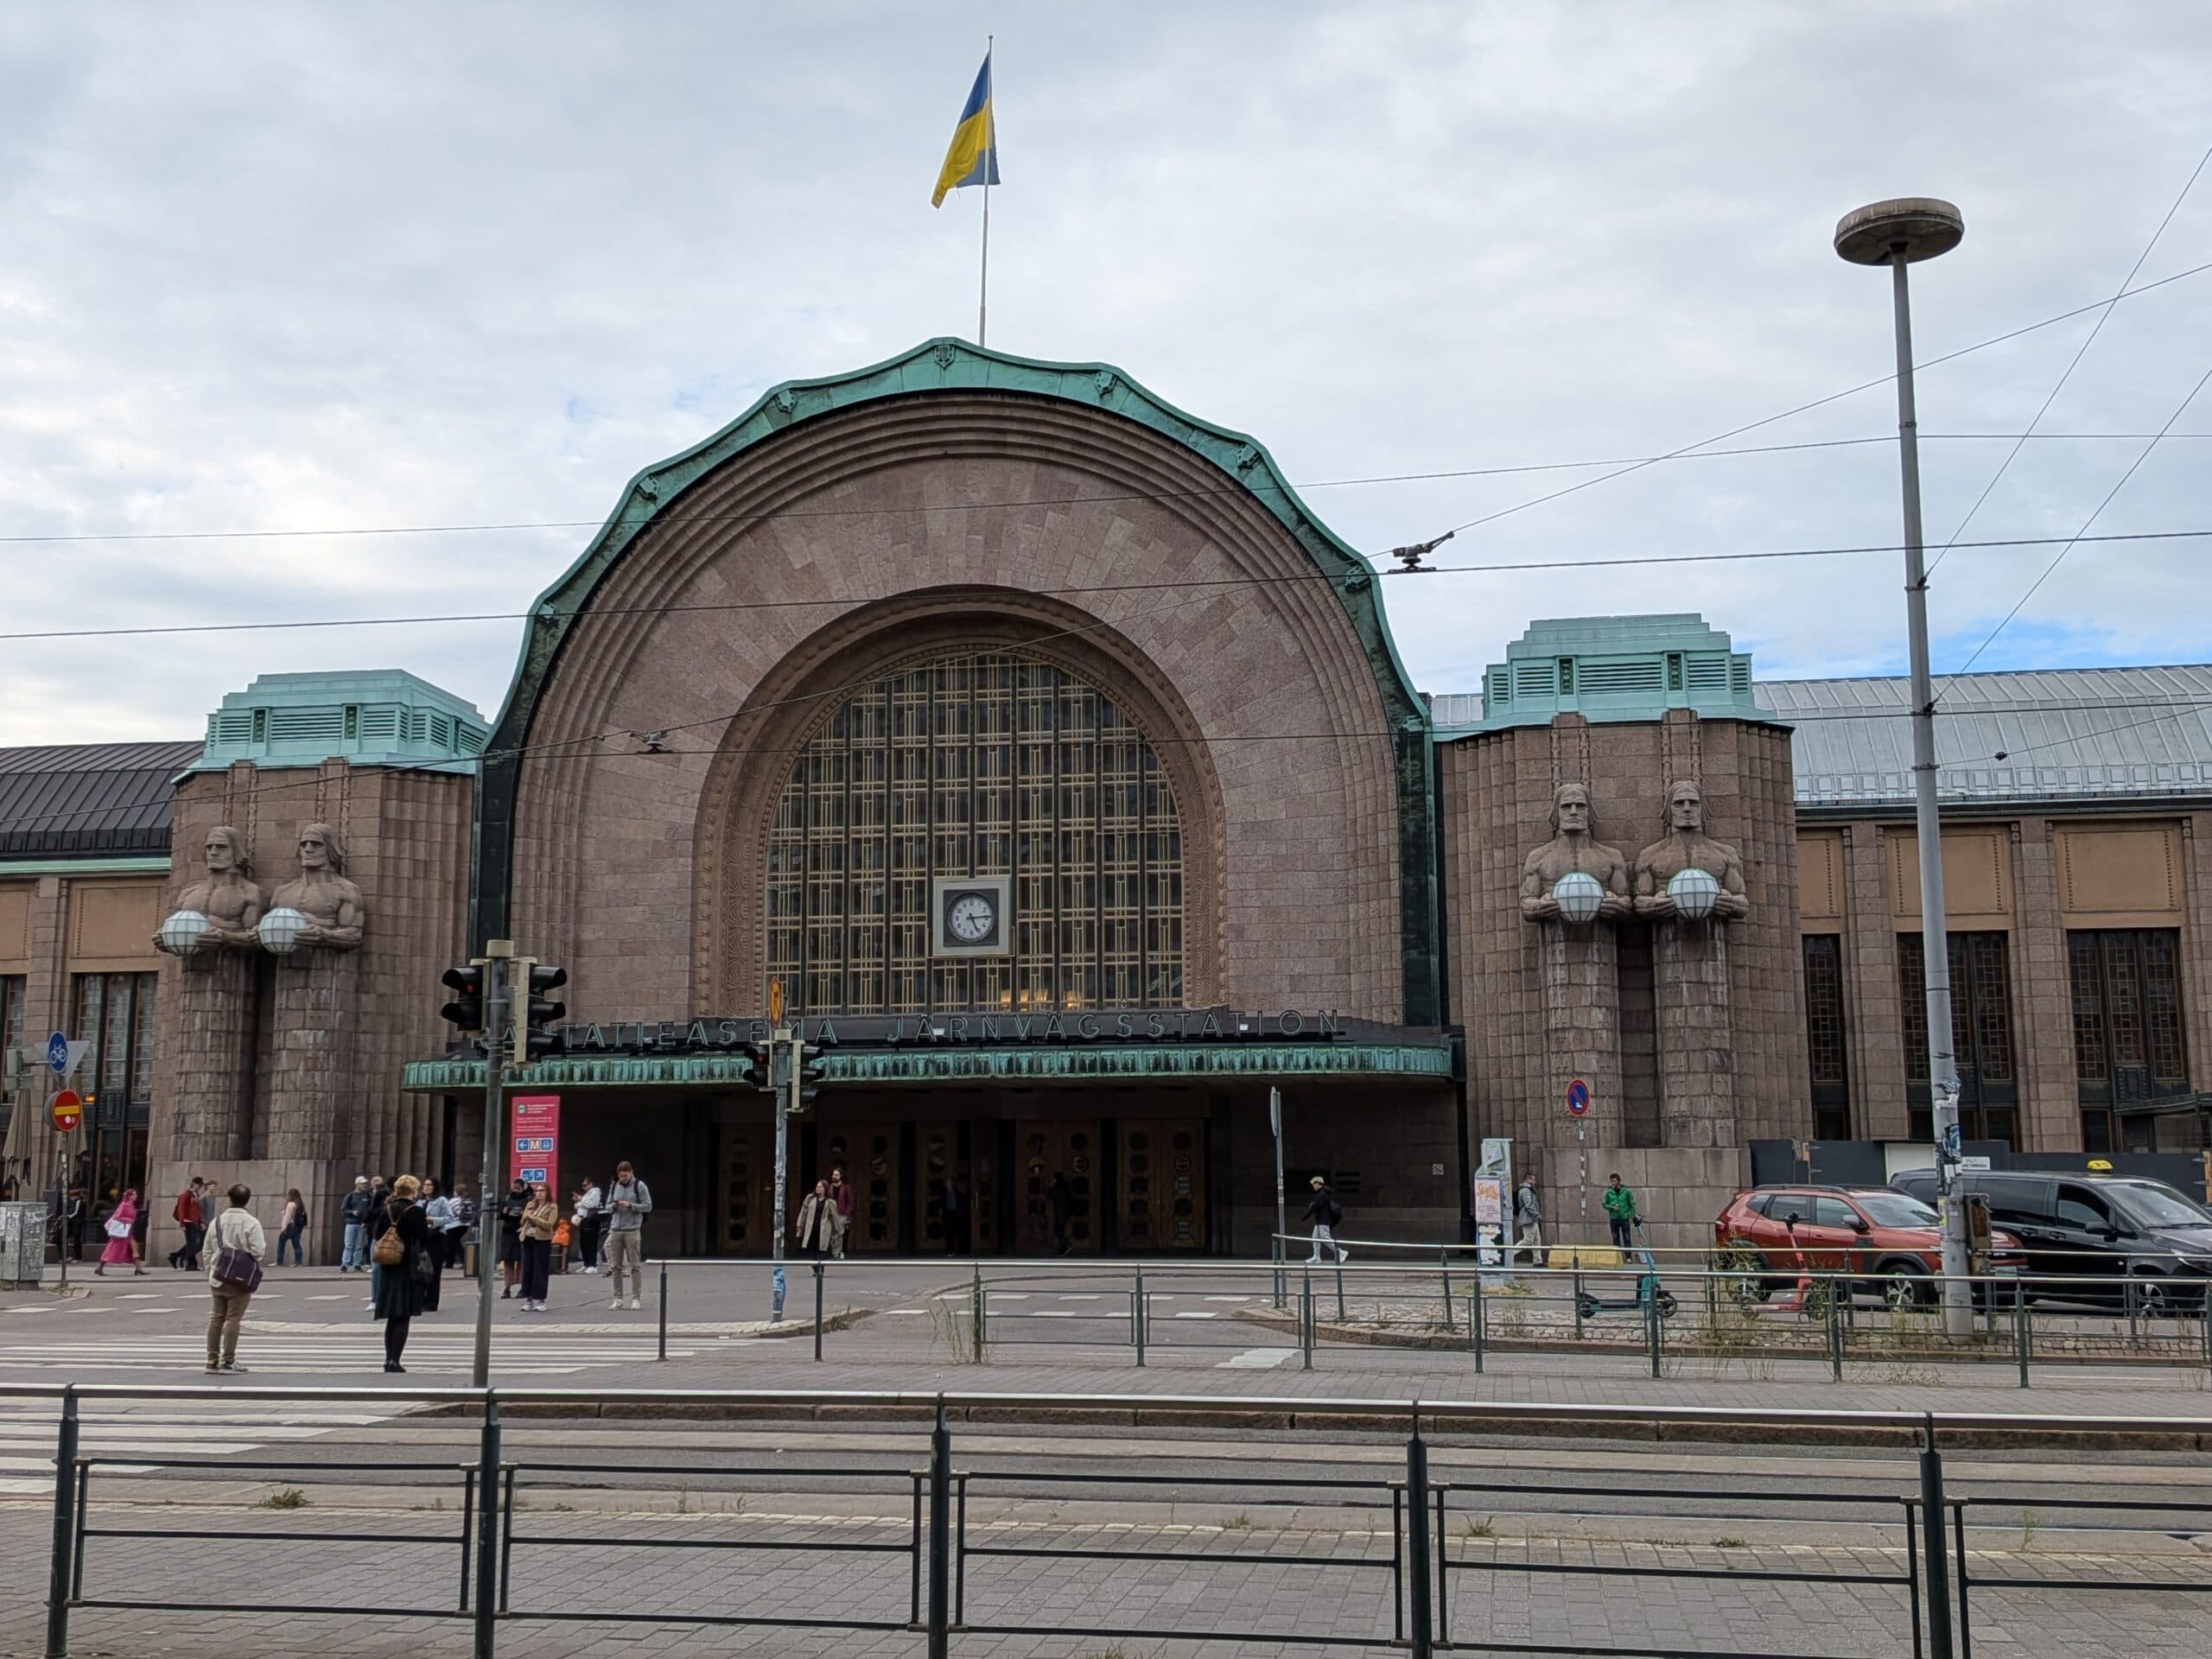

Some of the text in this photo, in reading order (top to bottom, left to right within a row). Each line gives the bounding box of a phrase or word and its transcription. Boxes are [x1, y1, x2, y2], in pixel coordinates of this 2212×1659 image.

[471, 1010, 1338, 1049] ATATIEASEMA JÄRNVÄGSSTATION
[530, 1140, 540, 1150] M
